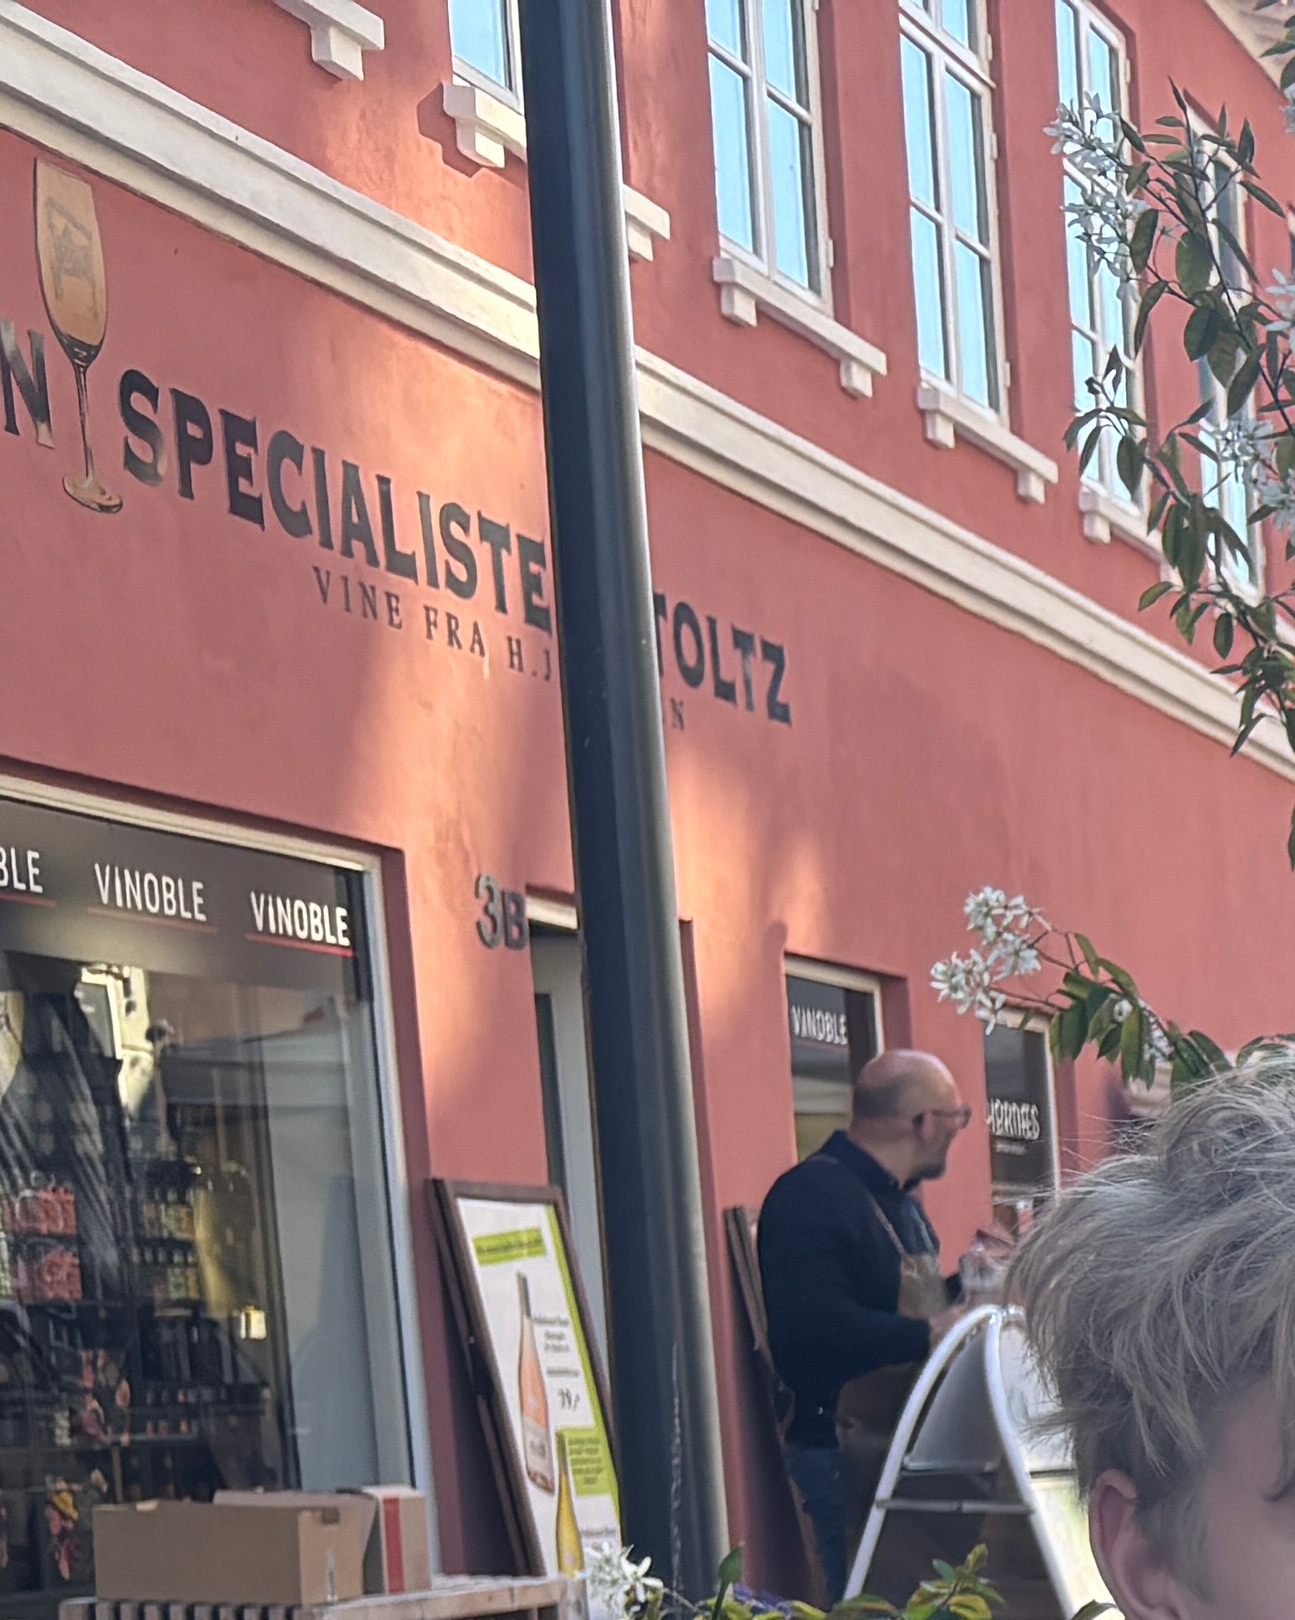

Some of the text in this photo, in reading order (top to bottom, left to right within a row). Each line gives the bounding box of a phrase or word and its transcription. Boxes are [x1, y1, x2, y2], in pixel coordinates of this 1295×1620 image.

[312, 566, 403, 630] VINE
[424, 605, 485, 657] FRA
[94, 863, 207, 922] VINOBLE
[250, 891, 351, 946] VINOBLE
[475, 873, 528, 951] 3B
[791, 1005, 848, 1046] VINOBLE
